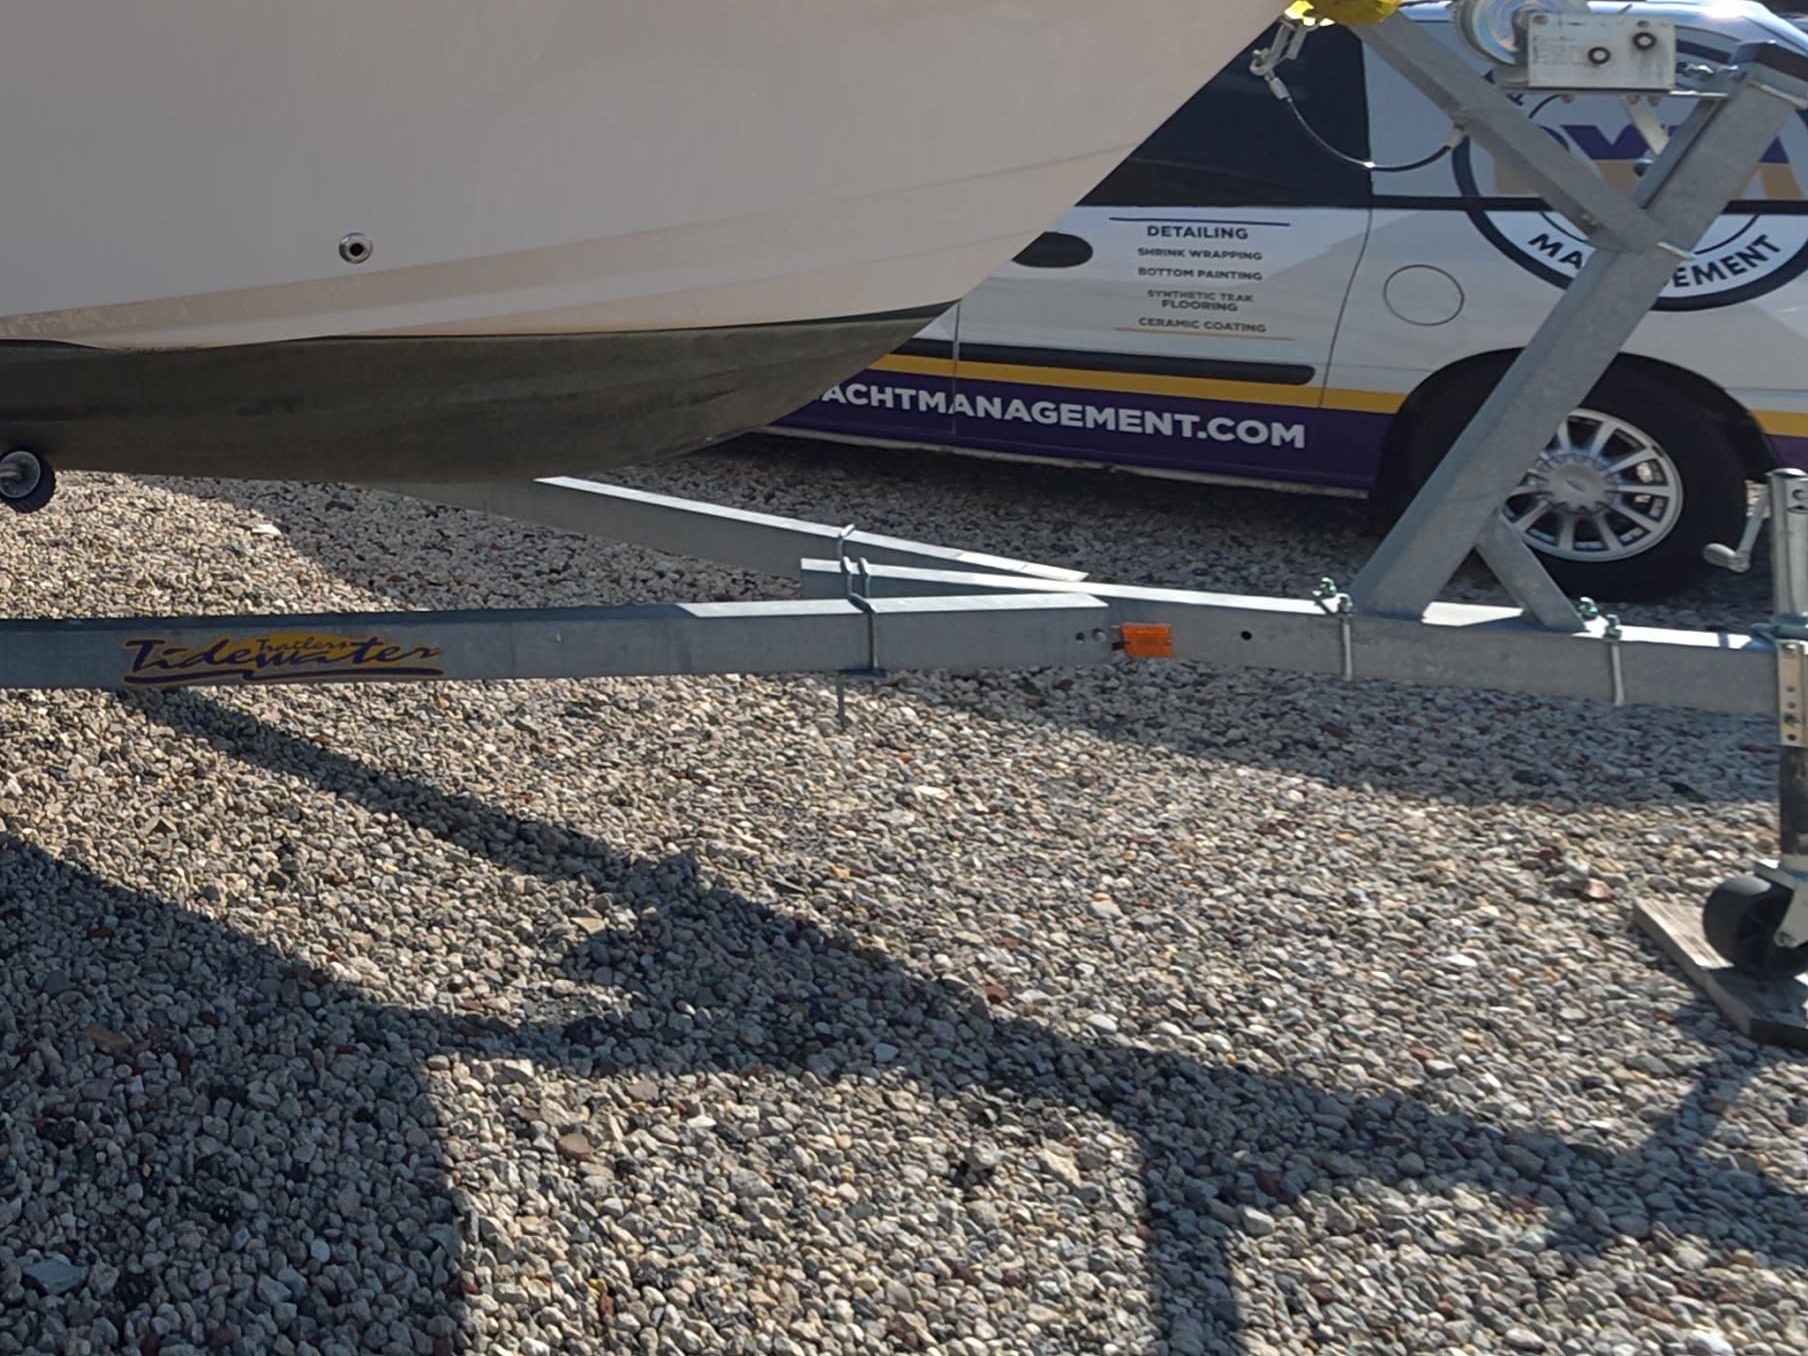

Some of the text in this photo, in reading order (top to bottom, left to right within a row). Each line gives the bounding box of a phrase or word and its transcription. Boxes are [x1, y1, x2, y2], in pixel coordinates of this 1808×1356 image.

[1147, 225, 1248, 240] DETAILING
[1137, 247, 1263, 261] SHRINK WRAPPING
[1528, 232, 1781, 289] MAEMENT
[1138, 267, 1263, 281] BOTTOM PAINTING
[1147, 289, 1254, 303] SYNTHETIC TEAK
[1161, 299, 1238, 312] FLOORING
[1138, 317, 1267, 333] CERAMIC COATING
[820, 382, 1305, 449] ACHTMANAGEMENT.COM
[124, 635, 442, 673] Tidewater
